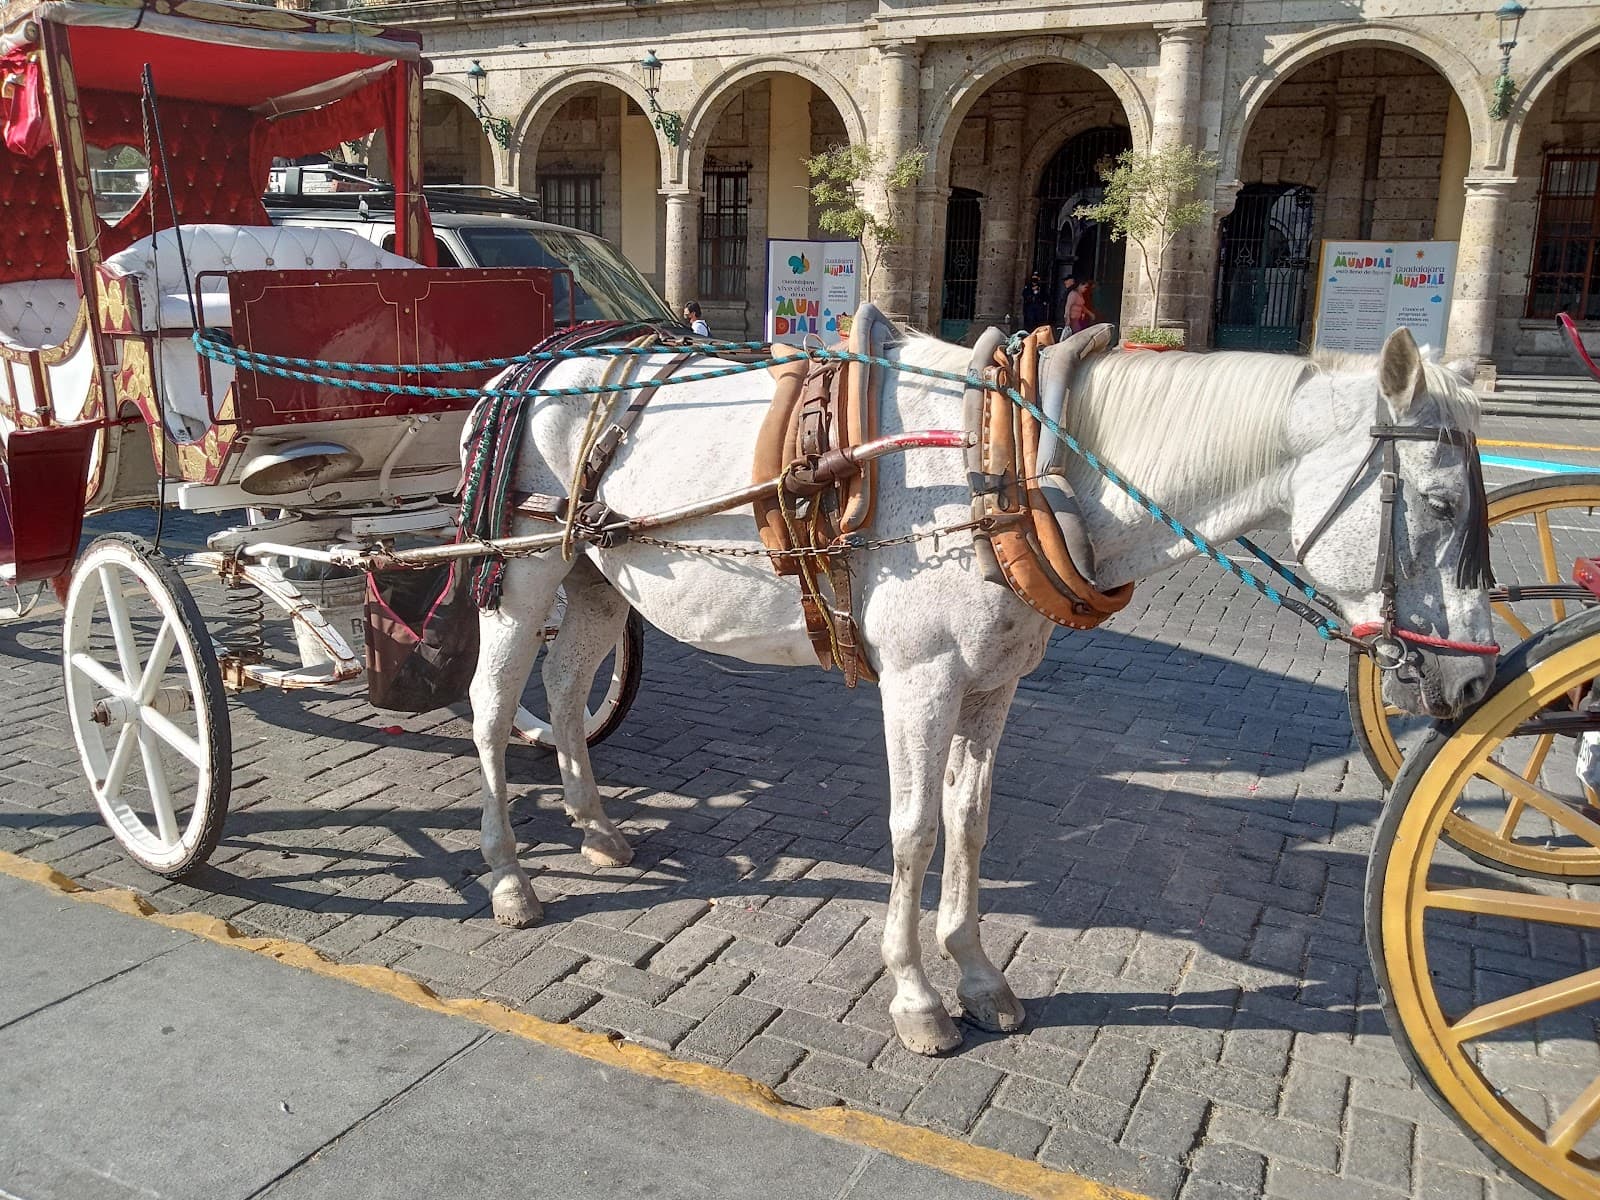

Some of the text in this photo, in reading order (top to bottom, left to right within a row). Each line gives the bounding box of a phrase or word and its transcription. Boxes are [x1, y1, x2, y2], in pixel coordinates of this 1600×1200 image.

[1334, 255, 1392, 268] MUNDIAL
[824, 264, 854, 277] MUNDIAL
[1395, 265, 1445, 273] Guadalajara
[1393, 273, 1445, 288] MUNDIAL
[776, 298, 820, 317] MUN
[776, 316, 819, 334] DIAL
